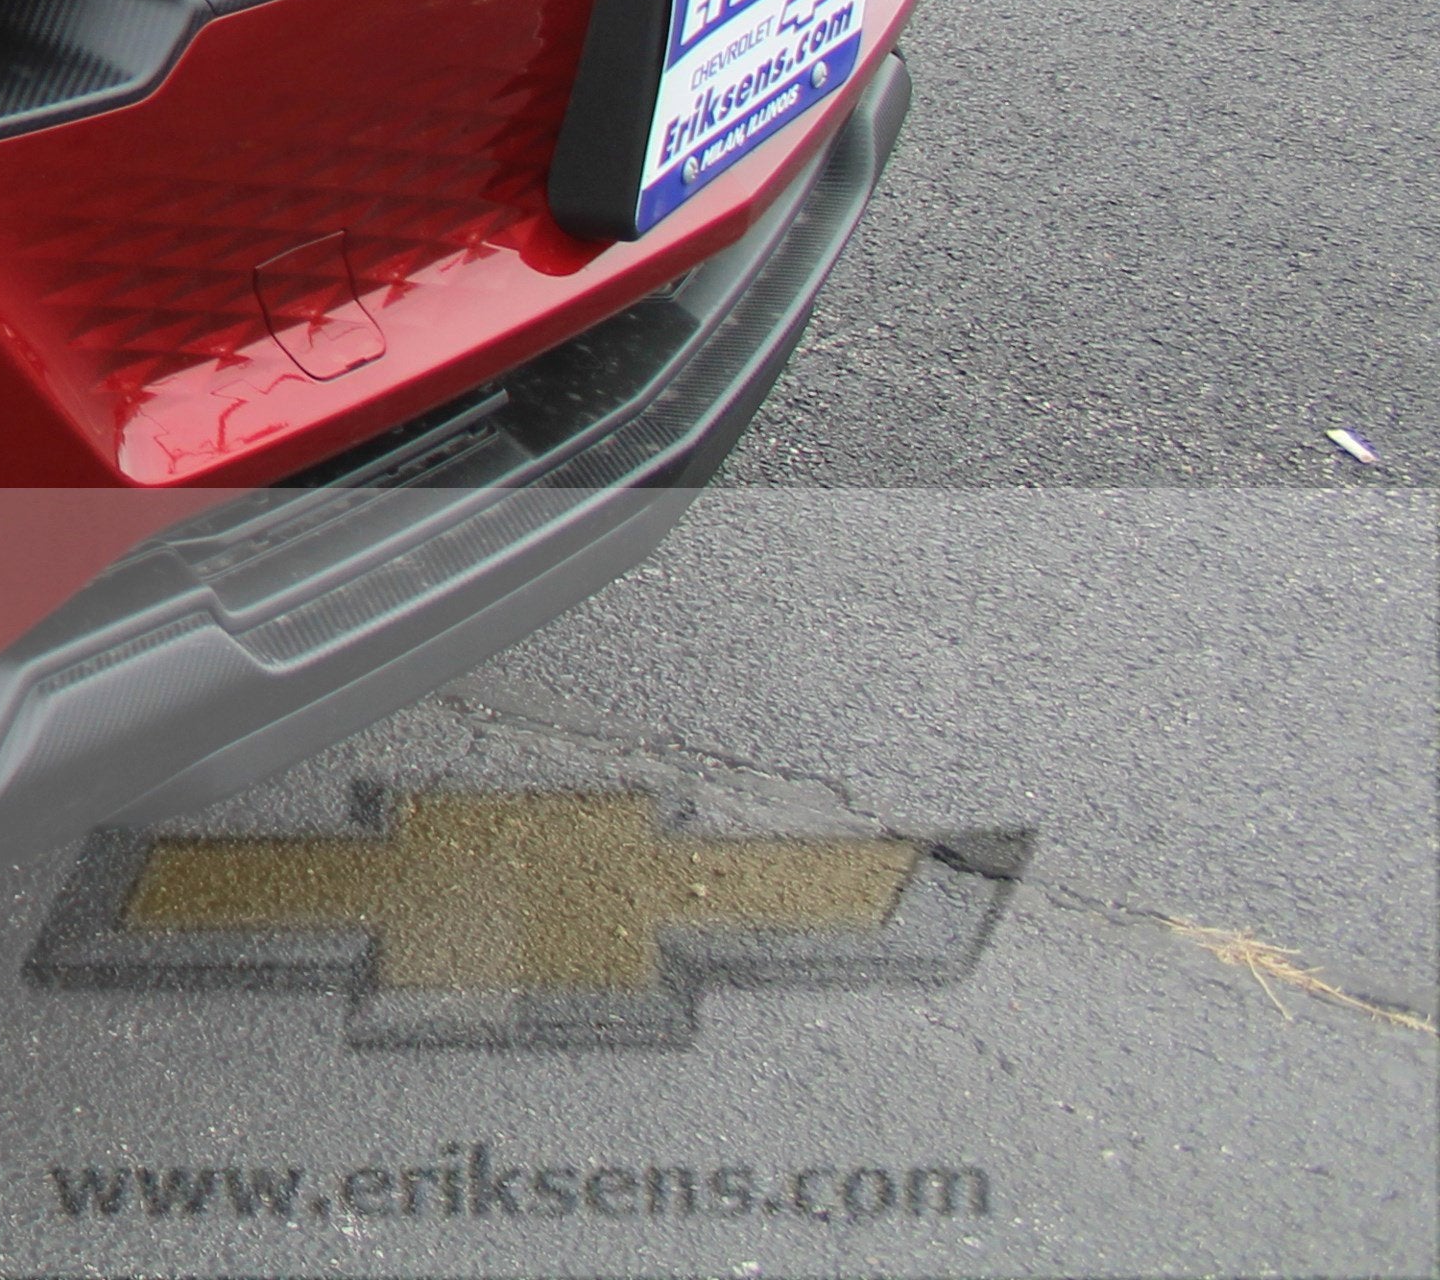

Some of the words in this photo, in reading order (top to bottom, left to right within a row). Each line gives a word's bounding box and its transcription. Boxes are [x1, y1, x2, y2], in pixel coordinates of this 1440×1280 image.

[657, 1, 853, 170] Eriksens.com
[691, 15, 775, 91] CHEVROLET
[745, 83, 801, 138] ILLINOIS
